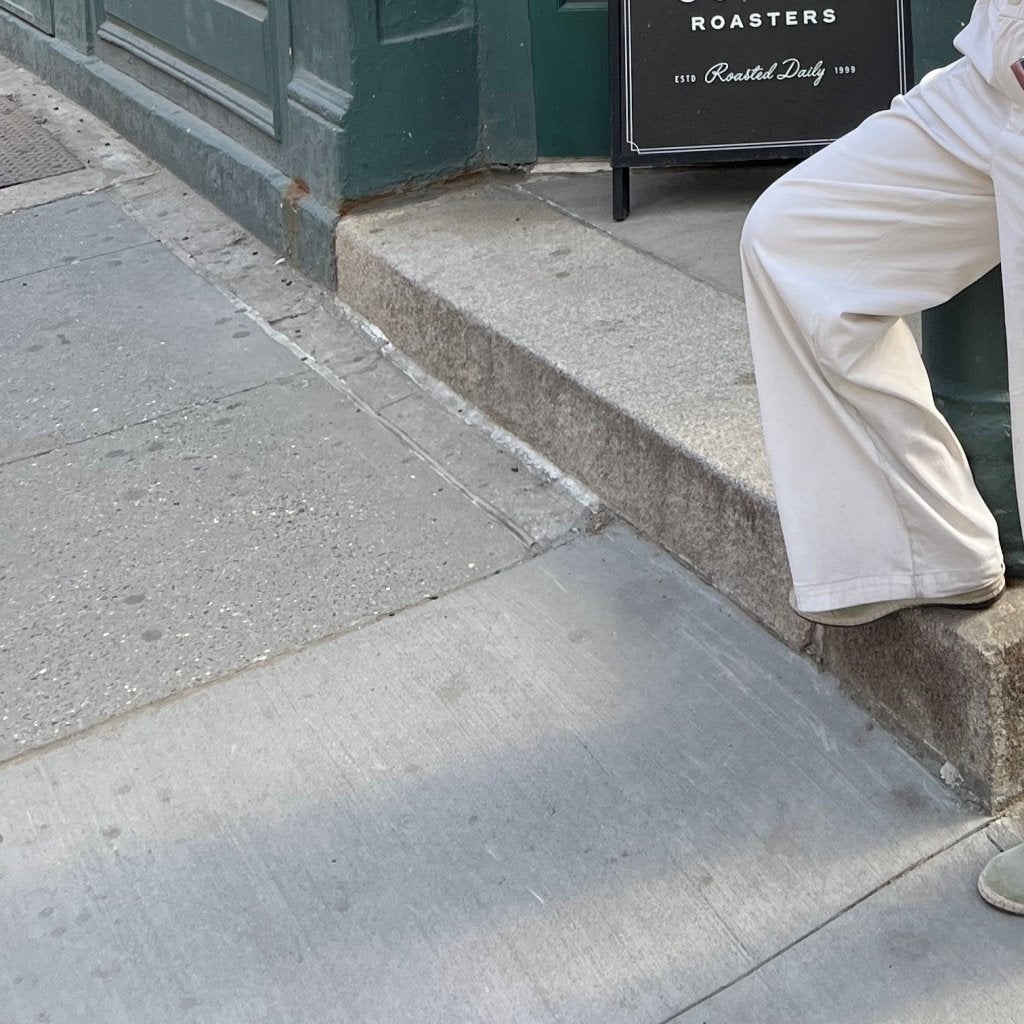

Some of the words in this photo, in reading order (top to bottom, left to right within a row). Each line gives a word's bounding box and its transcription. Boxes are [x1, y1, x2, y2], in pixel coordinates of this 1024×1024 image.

[691, 8, 836, 31] ROASTERS
[674, 74, 697, 84] ESTD
[704, 62, 775, 84] Roasted
[776, 57, 826, 87] Daily
[834, 65, 856, 75] 1999
